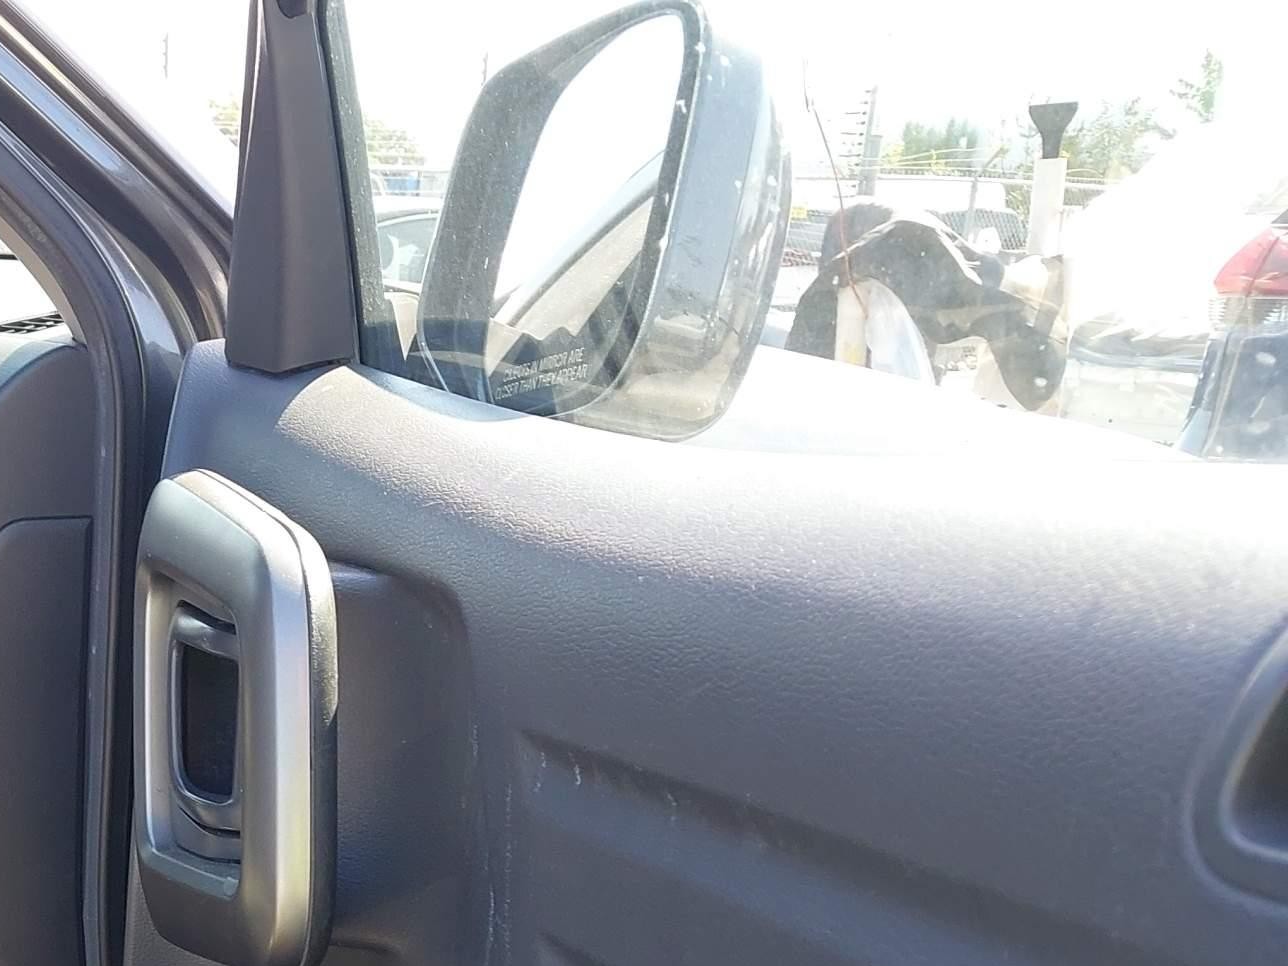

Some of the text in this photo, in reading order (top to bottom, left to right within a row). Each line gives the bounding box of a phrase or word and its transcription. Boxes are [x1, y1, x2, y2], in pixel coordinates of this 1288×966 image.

[567, 346, 586, 364] ARE
[518, 377, 539, 393] THAN
[555, 363, 589, 386] APPEAR
